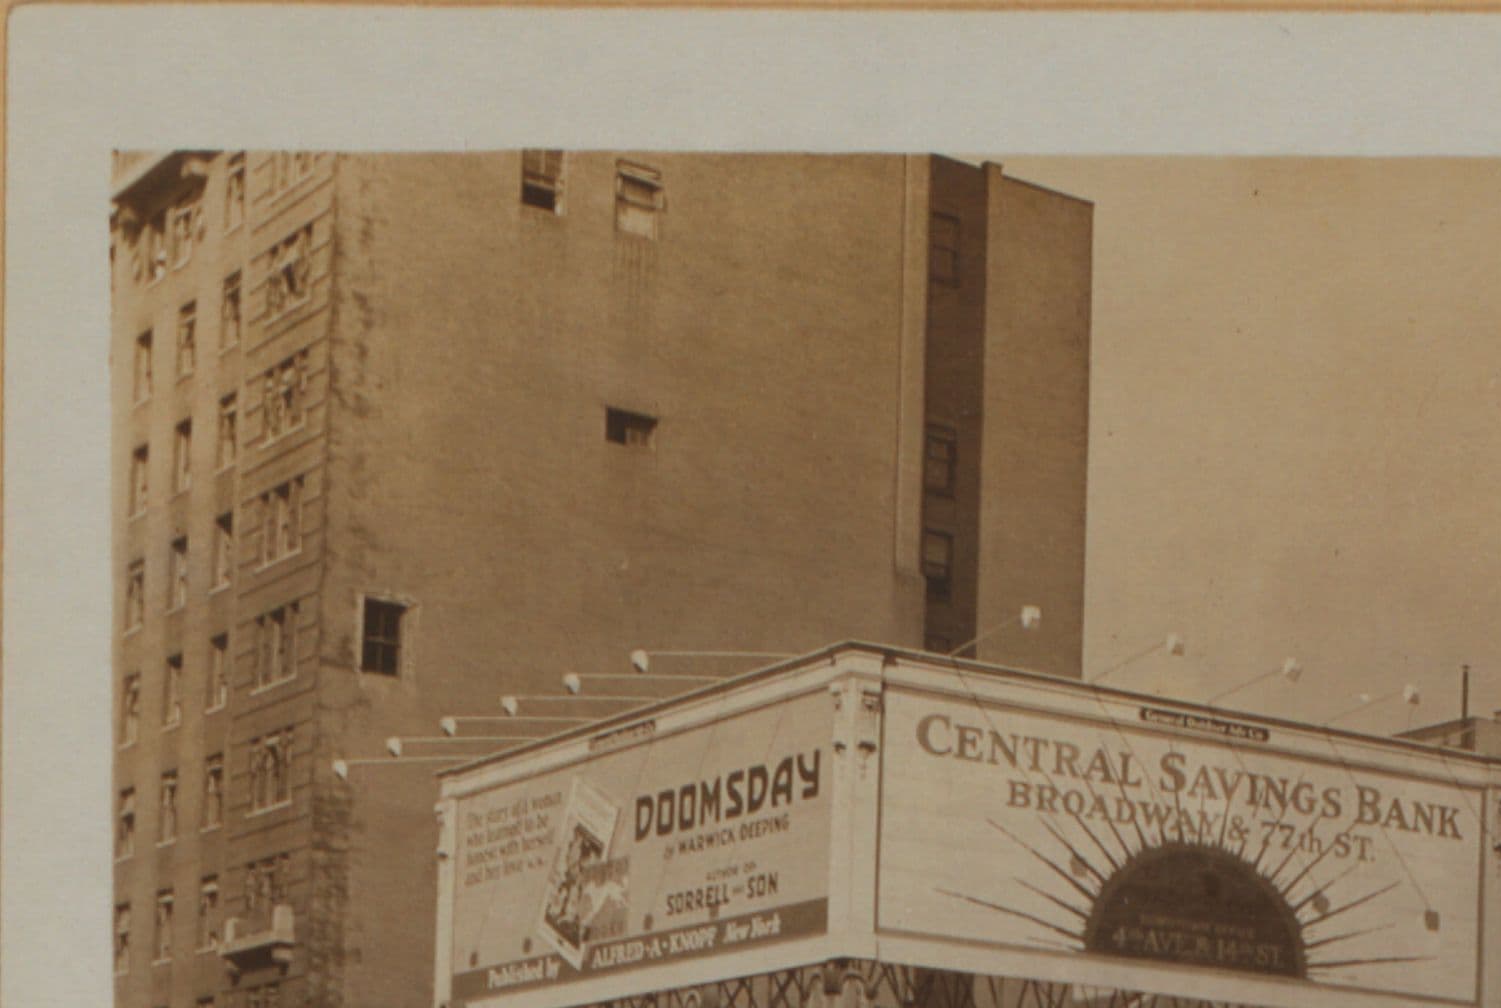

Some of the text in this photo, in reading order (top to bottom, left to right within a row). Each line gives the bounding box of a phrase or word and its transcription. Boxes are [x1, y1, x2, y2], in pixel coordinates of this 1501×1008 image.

[633, 747, 822, 843] DOOMSDAY
[915, 713, 1465, 840] CENTRAL SAVINGS BANK
[678, 827, 736, 854] WARWICK
[739, 811, 790, 842] DEEPING
[1005, 779, 1377, 863] BROADWAY & 77th ST.
[665, 882, 731, 917] SORRELL
[746, 871, 779, 900] SON
[591, 940, 645, 969] ALFRED
[668, 925, 717, 952] KNOPF
[722, 922, 750, 944] New
[750, 911, 782, 942] York
[486, 957, 561, 990] Published by
